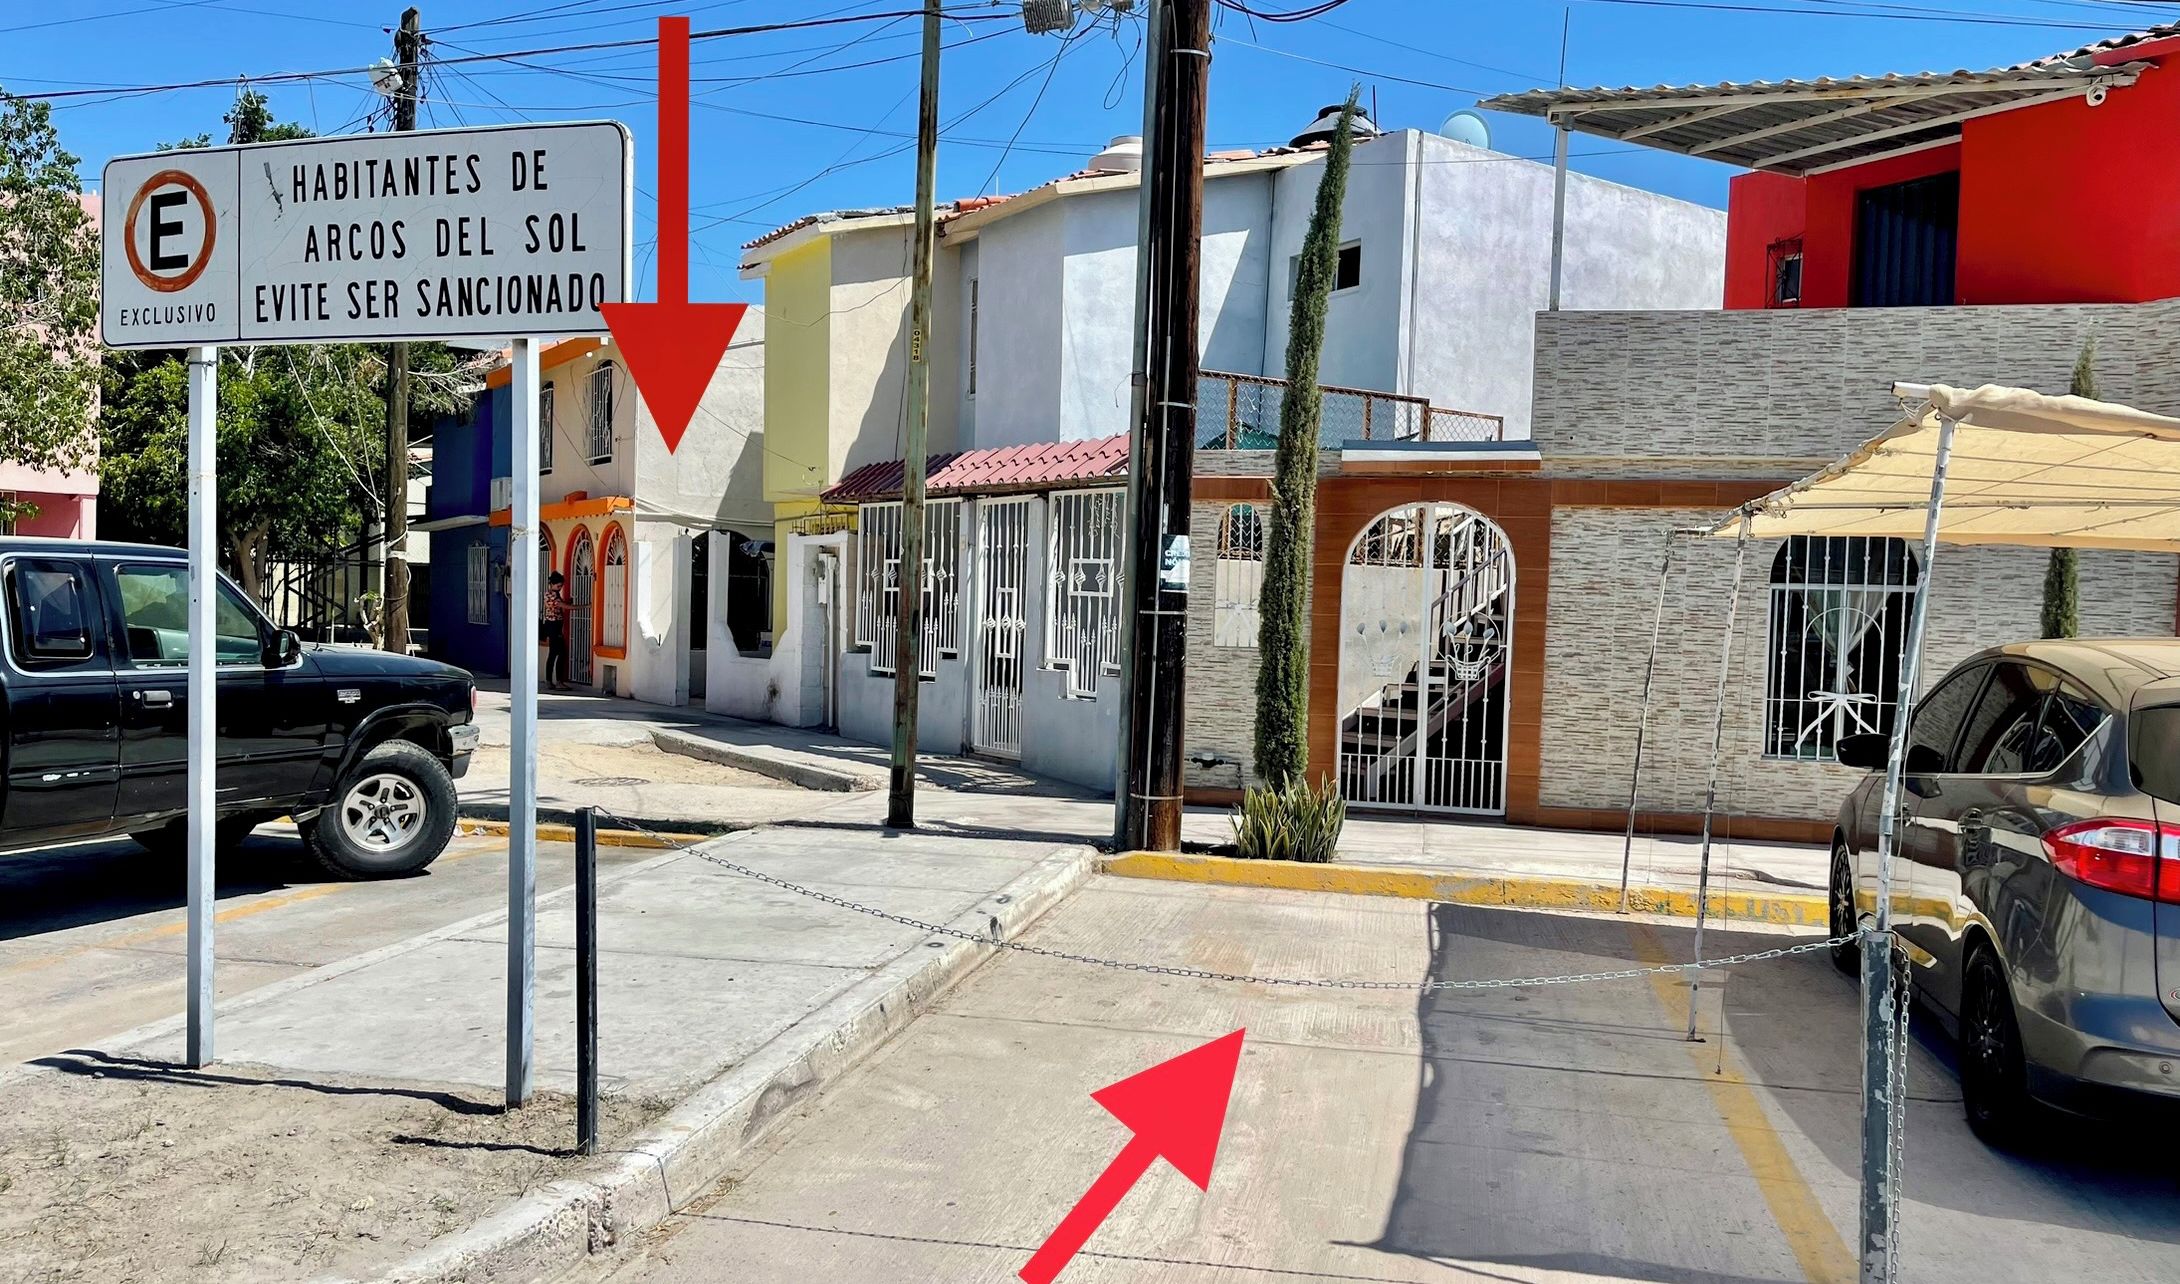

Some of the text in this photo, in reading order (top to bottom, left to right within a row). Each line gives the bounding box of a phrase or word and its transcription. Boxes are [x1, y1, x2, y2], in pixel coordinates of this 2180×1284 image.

[292, 149, 548, 204] HABITANTES DE
[149, 190, 190, 272] E
[304, 211, 586, 263] ARCOS DEL SOL
[120, 302, 217, 326] EXCLUSIVO
[255, 272, 605, 323] EVITE SER SANCIONADO
